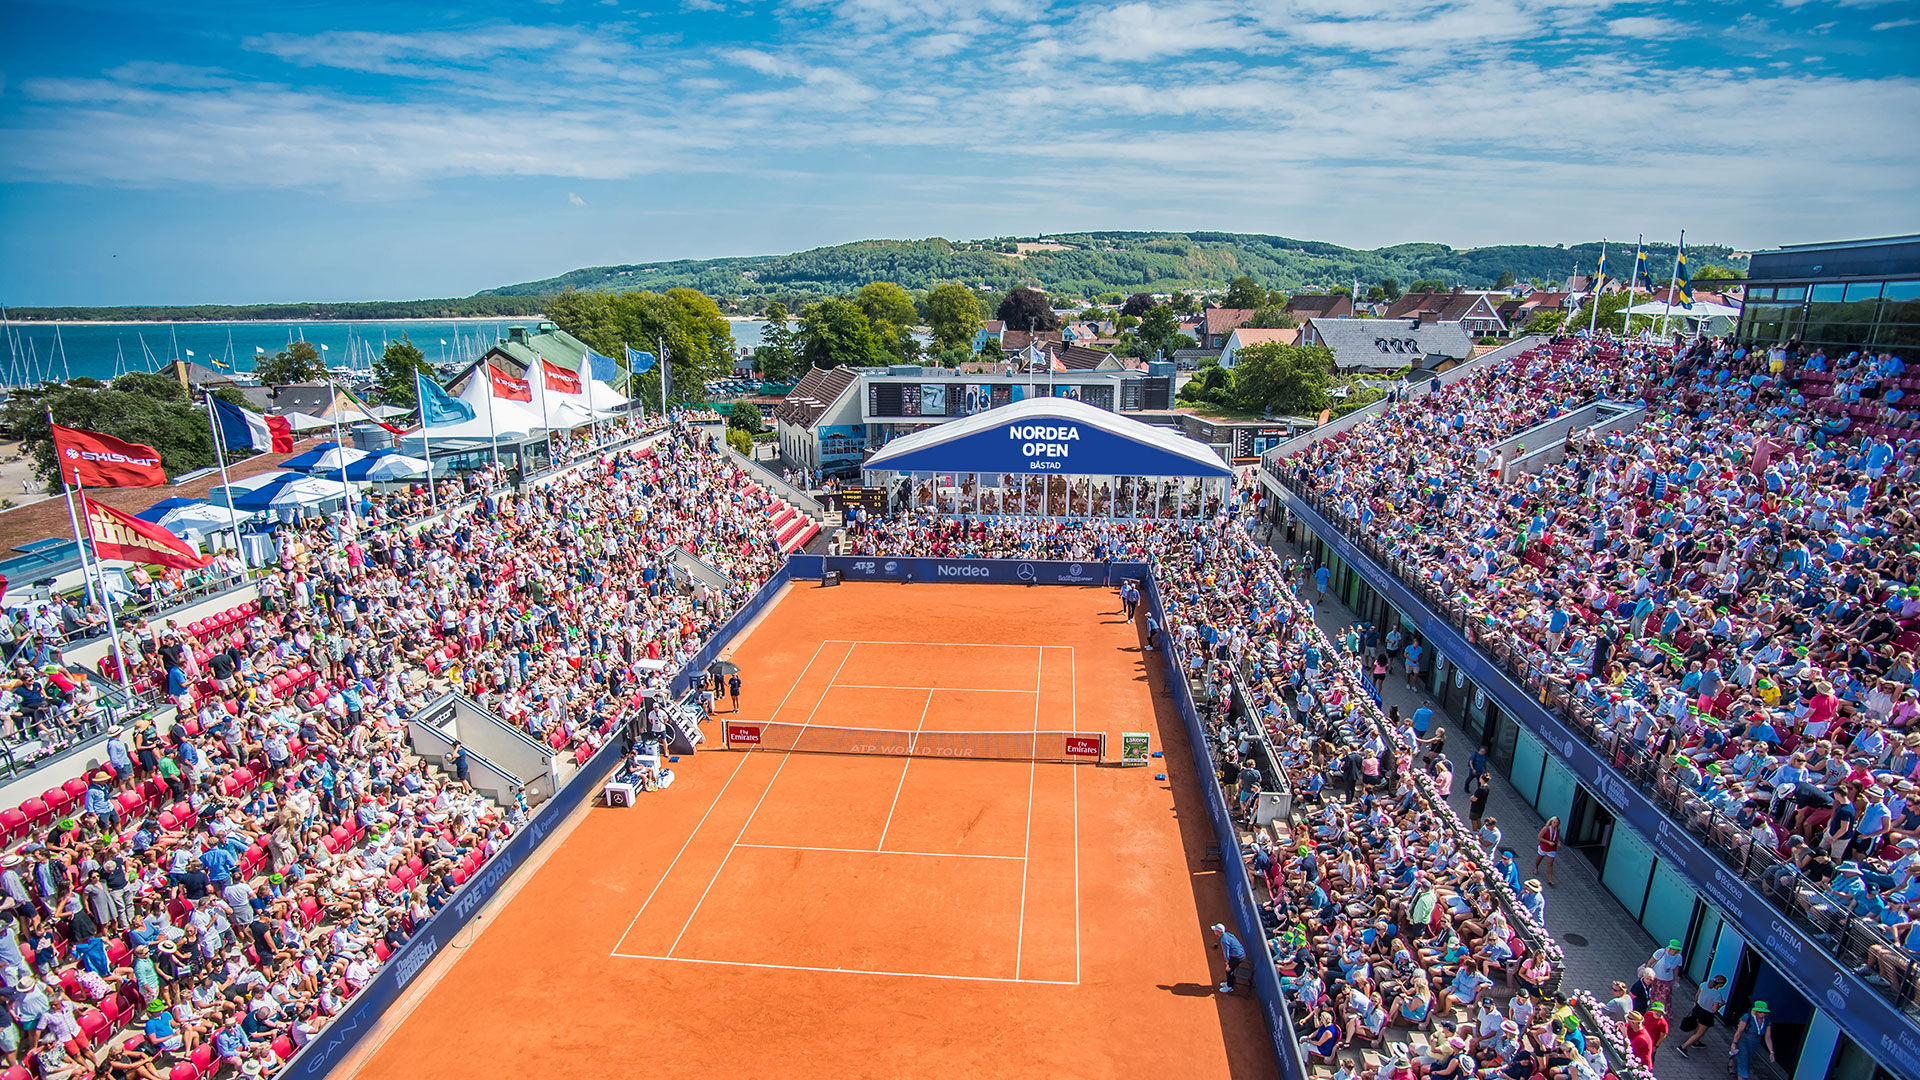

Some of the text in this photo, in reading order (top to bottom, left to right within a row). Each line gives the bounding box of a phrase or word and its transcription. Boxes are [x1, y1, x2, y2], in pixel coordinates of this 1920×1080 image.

[1009, 425, 1080, 440] NORDEA
[1022, 442, 1069, 457] OPEN
[1030, 461, 1061, 470] BÅSTAD
[937, 564, 990, 577] Nordea
[730, 733, 759, 741] Emirates
[849, 744, 877, 754] ATP
[935, 747, 973, 757] TOUR
[1067, 745, 1098, 754] Emirates
[454, 851, 513, 919] TRETORN
[1719, 873, 1744, 900] Brinova
[1705, 881, 1743, 919] KUNGSLEDEN
[1770, 920, 1803, 953] CATENA
[307, 1002, 370, 1073] GANT
